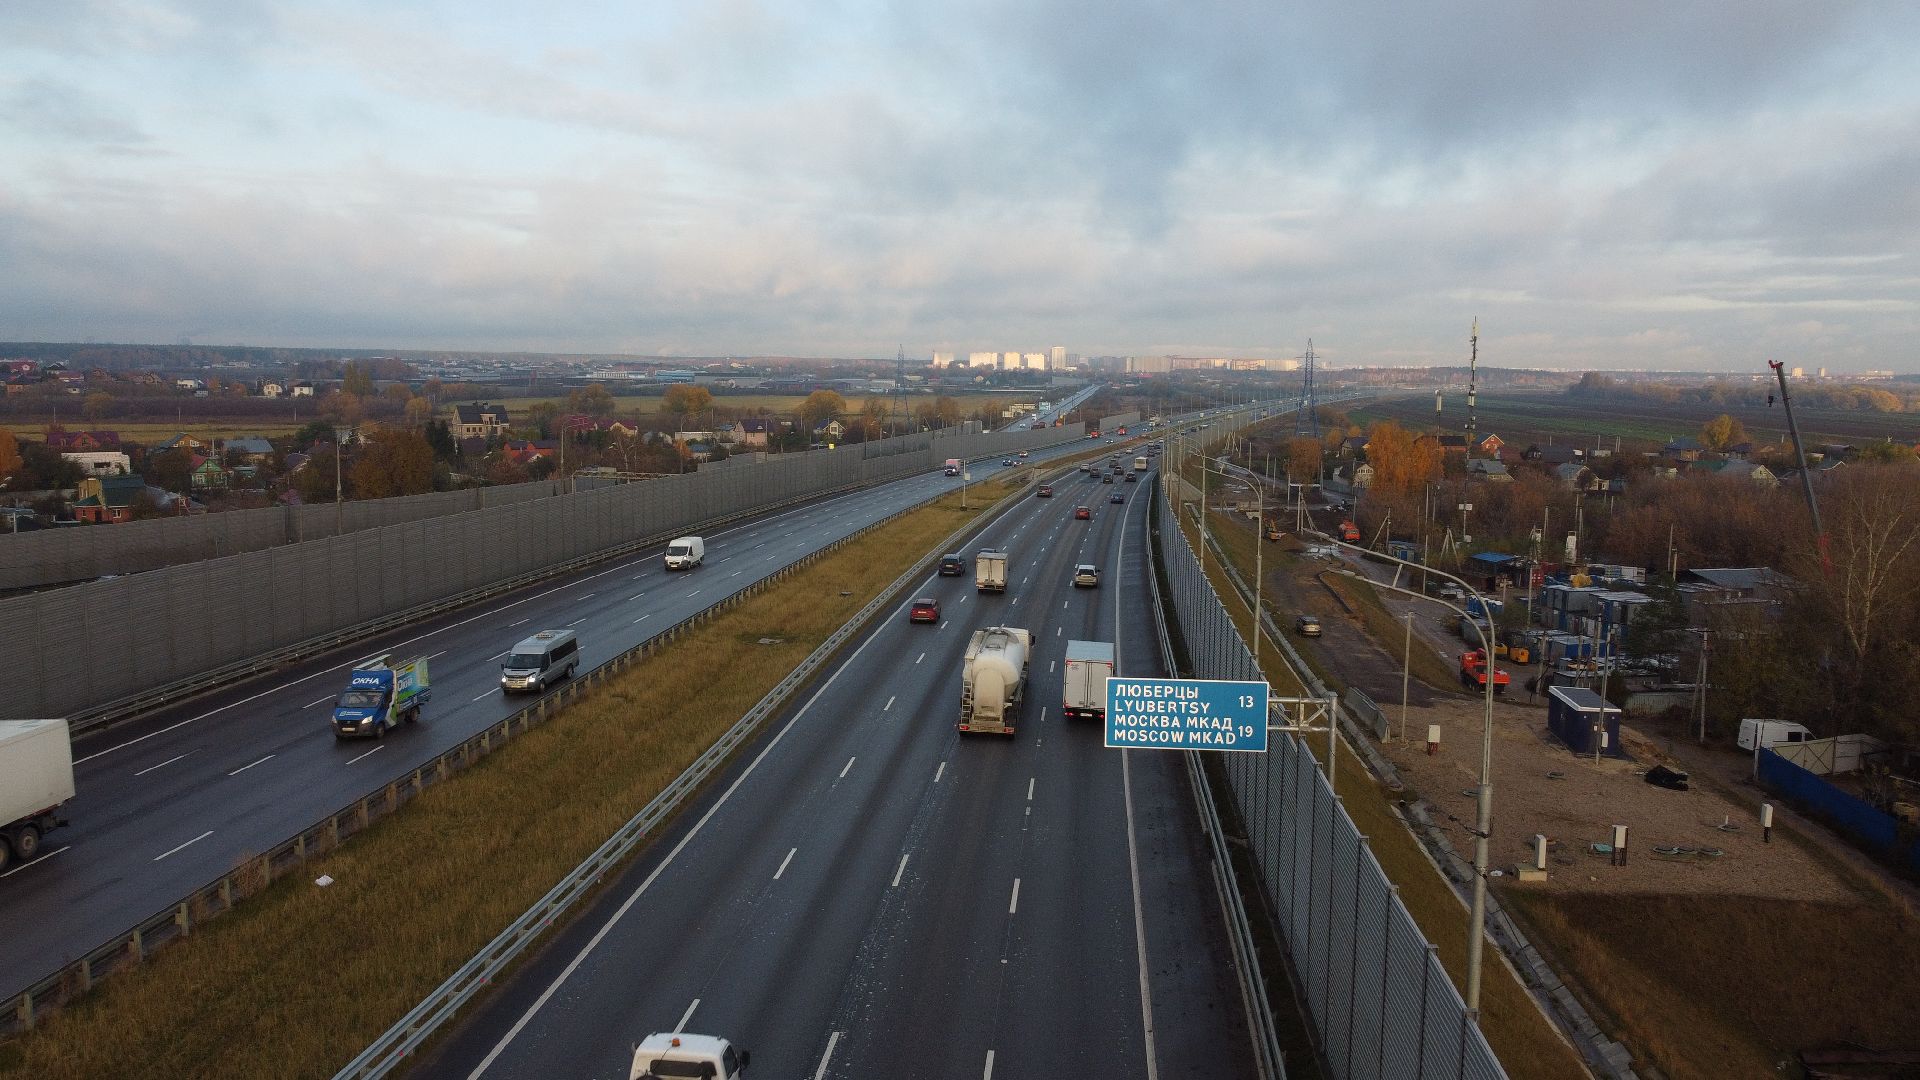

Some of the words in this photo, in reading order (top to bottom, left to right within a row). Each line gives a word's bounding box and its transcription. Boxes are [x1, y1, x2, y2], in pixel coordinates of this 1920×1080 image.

[1115, 684, 1199, 700] ЛЮБЕРЦЫ
[1115, 700, 1210, 714] LYUBERTSY
[1238, 695, 1254, 708] 13
[1115, 714, 1181, 728] МОСКВА
[1186, 716, 1233, 732] МКАД
[1114, 729, 1185, 743] MOSCOW
[1189, 731, 1236, 745] MKAD
[1237, 725, 1254, 738] 19
